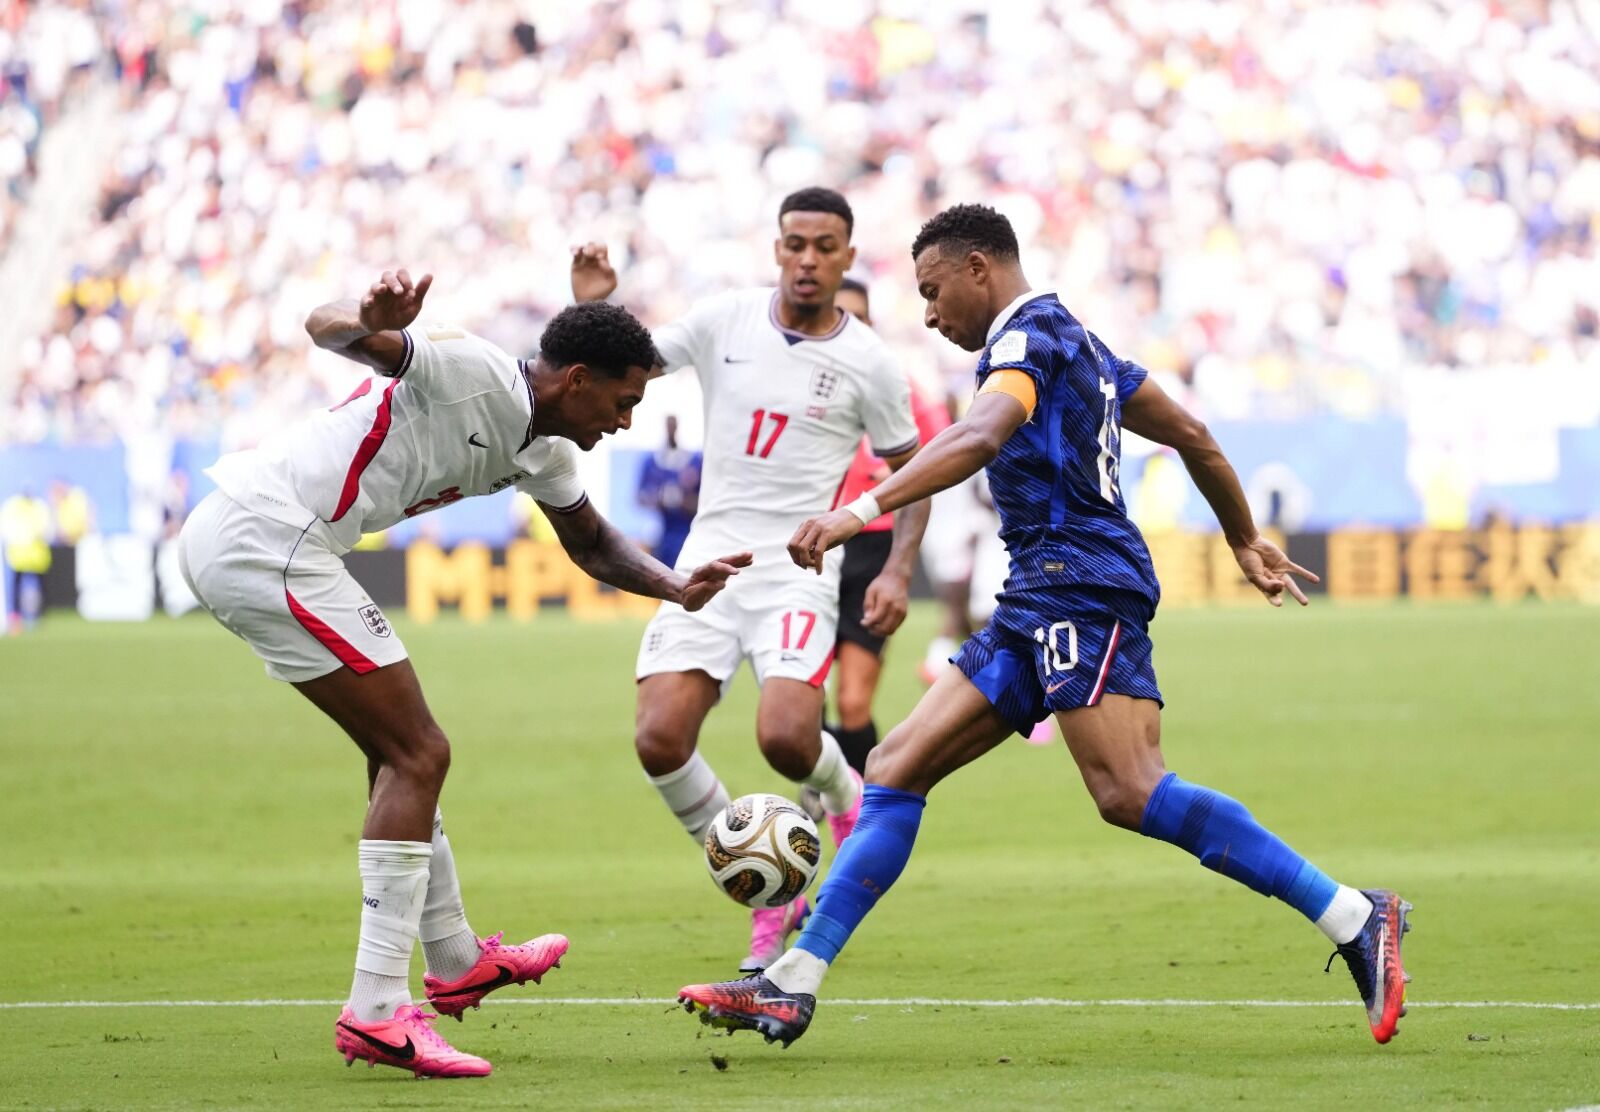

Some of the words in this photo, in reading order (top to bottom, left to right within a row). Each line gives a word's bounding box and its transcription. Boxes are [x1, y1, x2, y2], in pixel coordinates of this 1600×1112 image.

[745, 408, 790, 459] 17
[781, 610, 816, 651] 17
[1034, 620, 1079, 676] 10
[363, 896, 380, 909] NG
